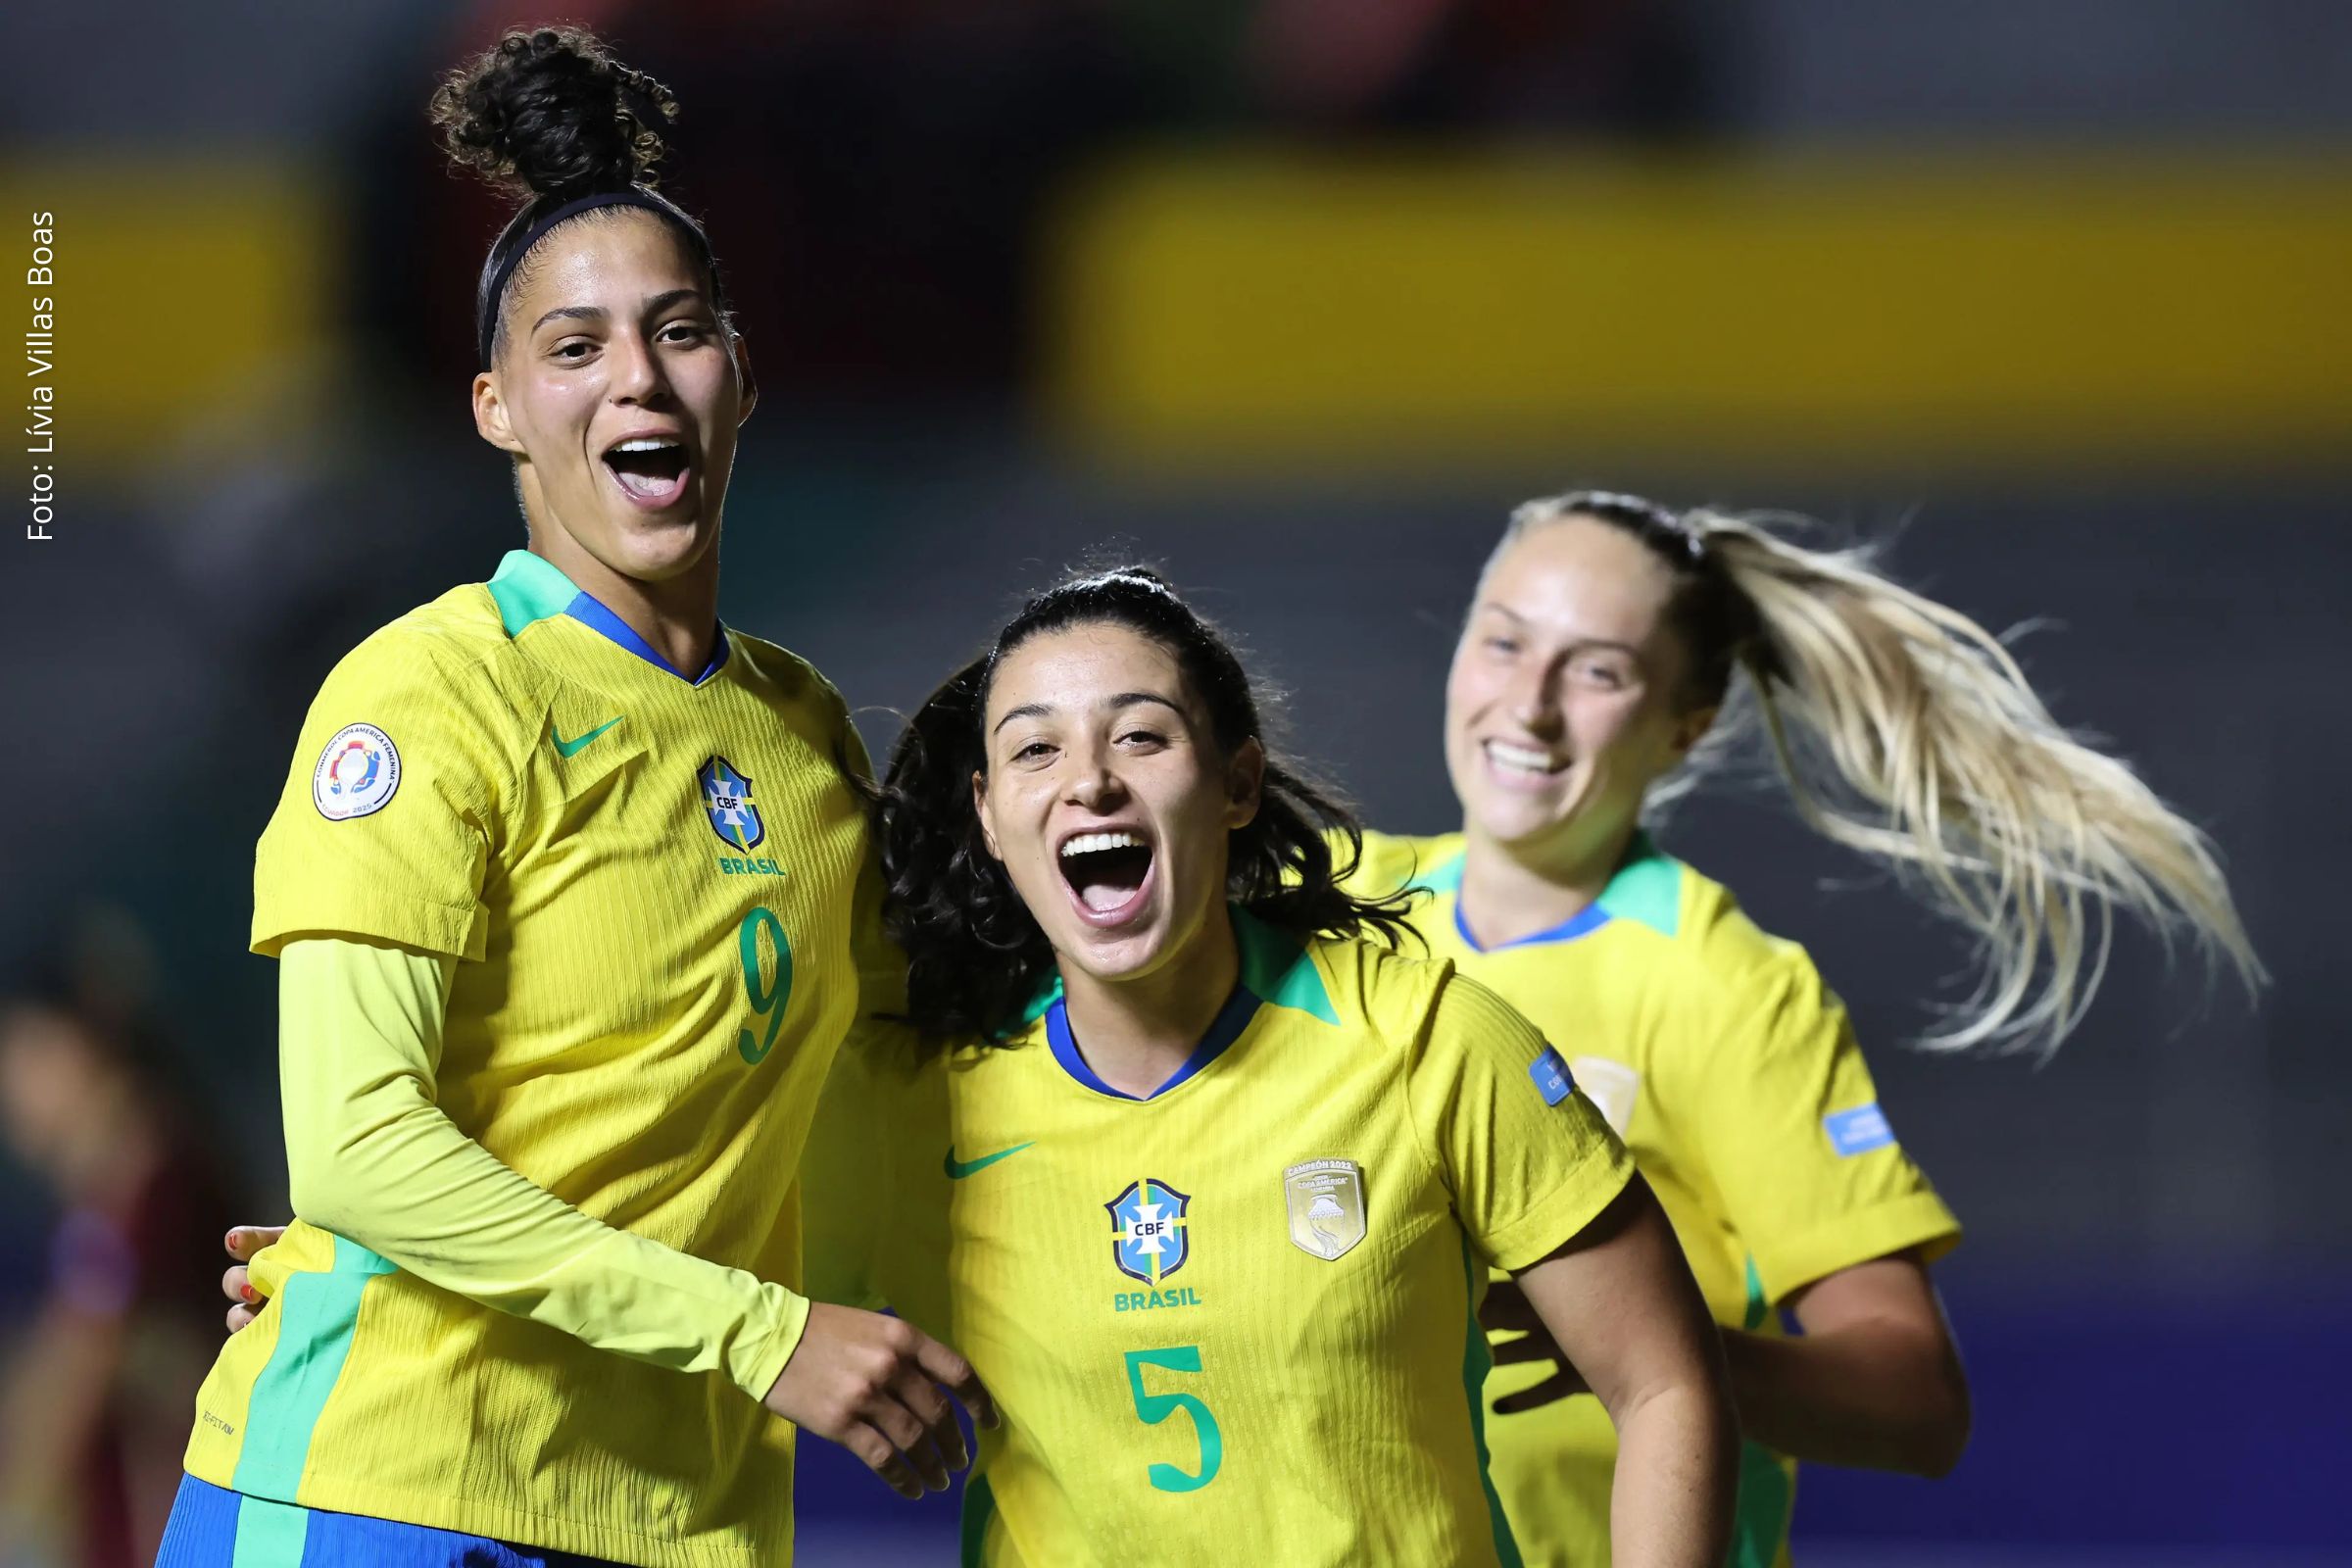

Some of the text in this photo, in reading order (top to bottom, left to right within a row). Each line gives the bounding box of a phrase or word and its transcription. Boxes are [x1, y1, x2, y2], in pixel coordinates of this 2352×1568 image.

[353, 804, 372, 813] 2025
[716, 797, 739, 810] CBF
[720, 858, 786, 876] BRASIL
[738, 906, 793, 1066] 9
[1288, 1159, 1352, 1176] CAMPEÓN 2022
[1135, 1221, 1165, 1237] CBF
[1114, 1288, 1201, 1312] BRASIL
[1124, 1345, 1223, 1493] 5
